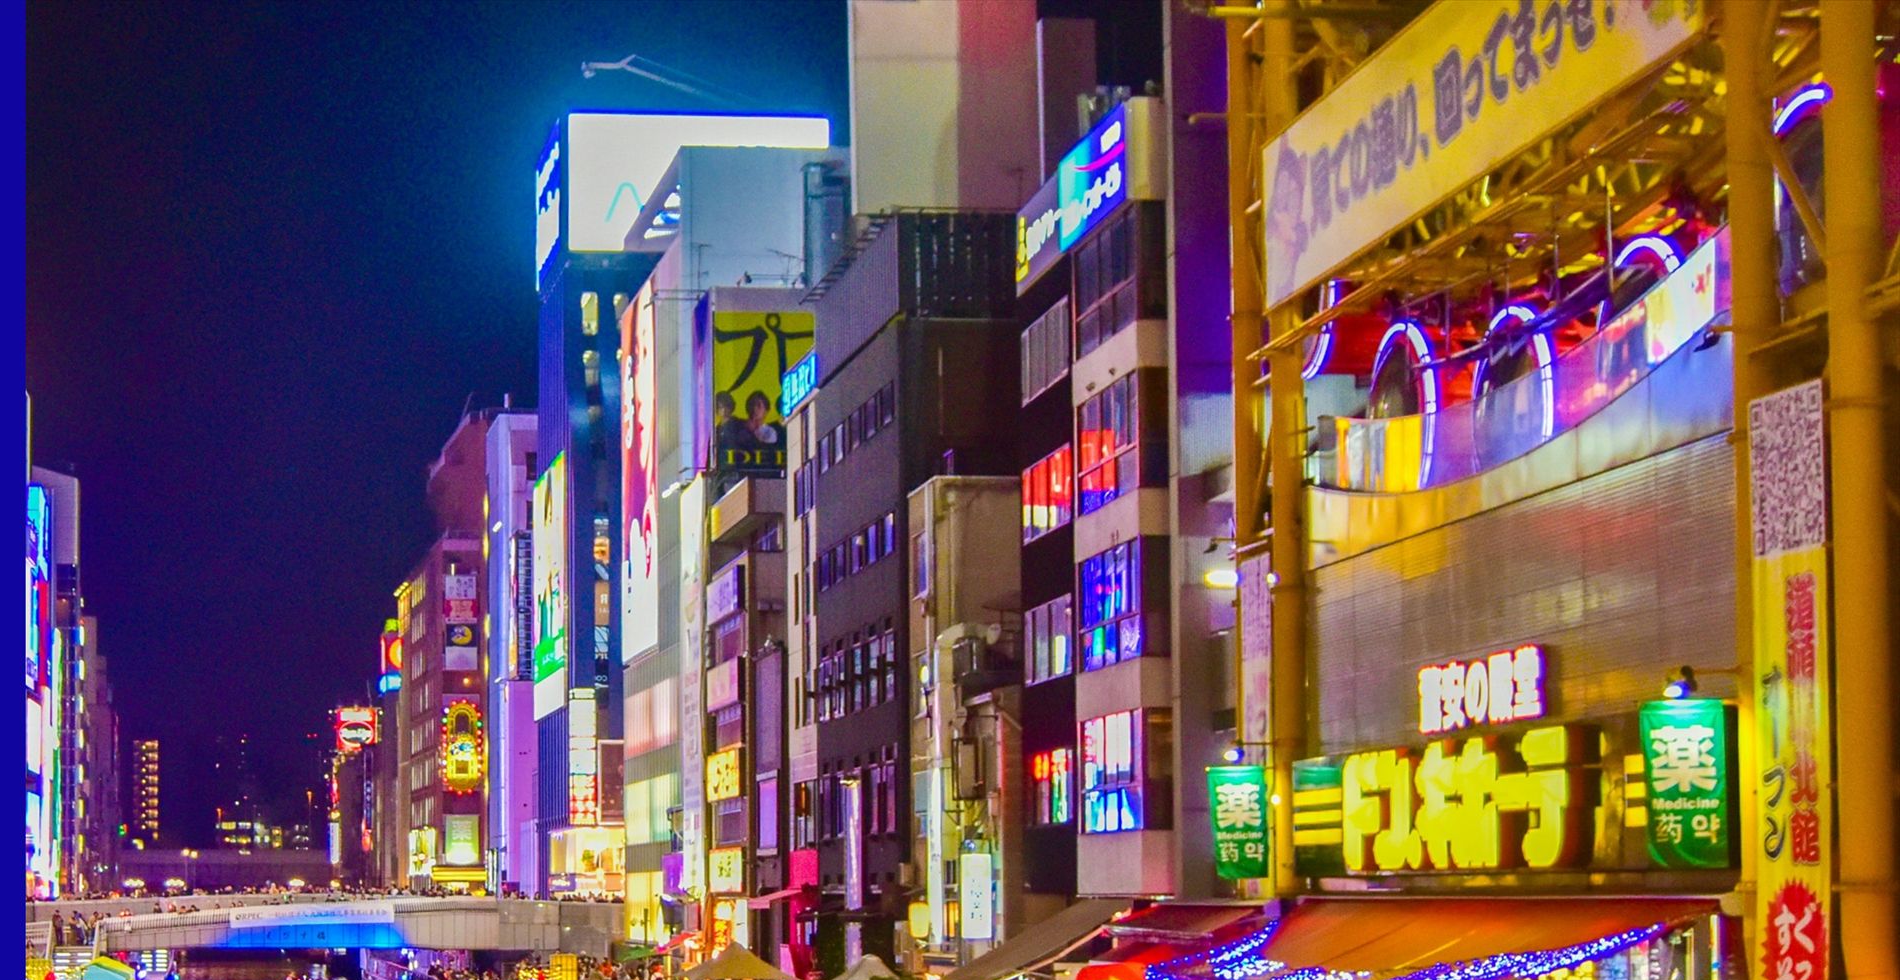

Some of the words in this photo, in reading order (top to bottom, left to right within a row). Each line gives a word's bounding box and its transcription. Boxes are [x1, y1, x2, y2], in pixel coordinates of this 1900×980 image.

[1650, 725, 1719, 792] 薬
[1215, 783, 1262, 828] 薬
[1652, 798, 1720, 811] Medicine
[1656, 814, 1682, 844] 药
[1691, 814, 1721, 844] 약
[1774, 903, 1817, 955] すぐ
